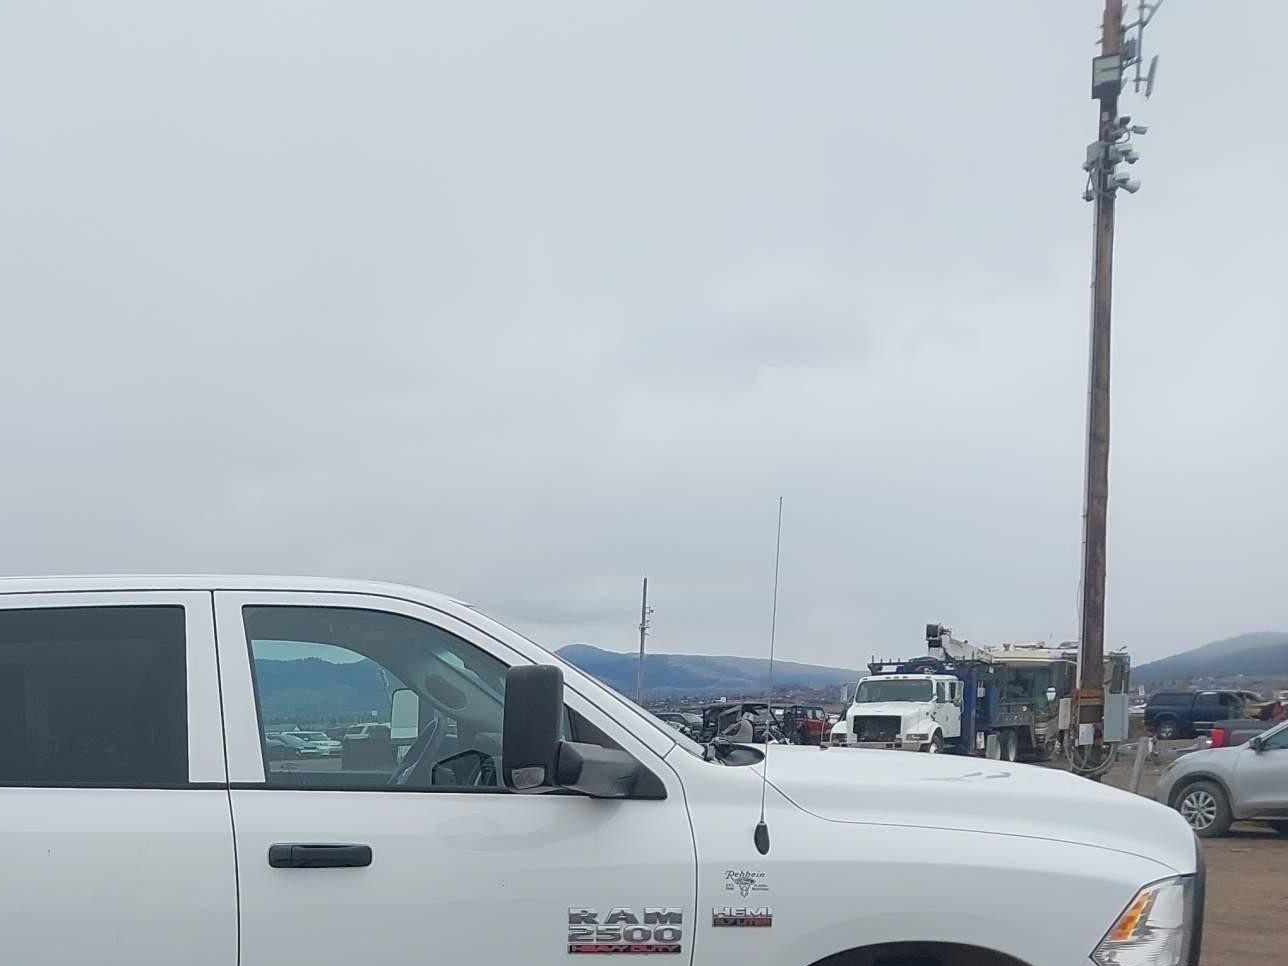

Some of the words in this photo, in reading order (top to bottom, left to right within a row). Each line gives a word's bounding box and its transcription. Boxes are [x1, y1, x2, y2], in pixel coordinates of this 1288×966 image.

[568, 907, 683, 925] RAM
[712, 906, 772, 918] HEMI
[568, 925, 682, 943] 2500
